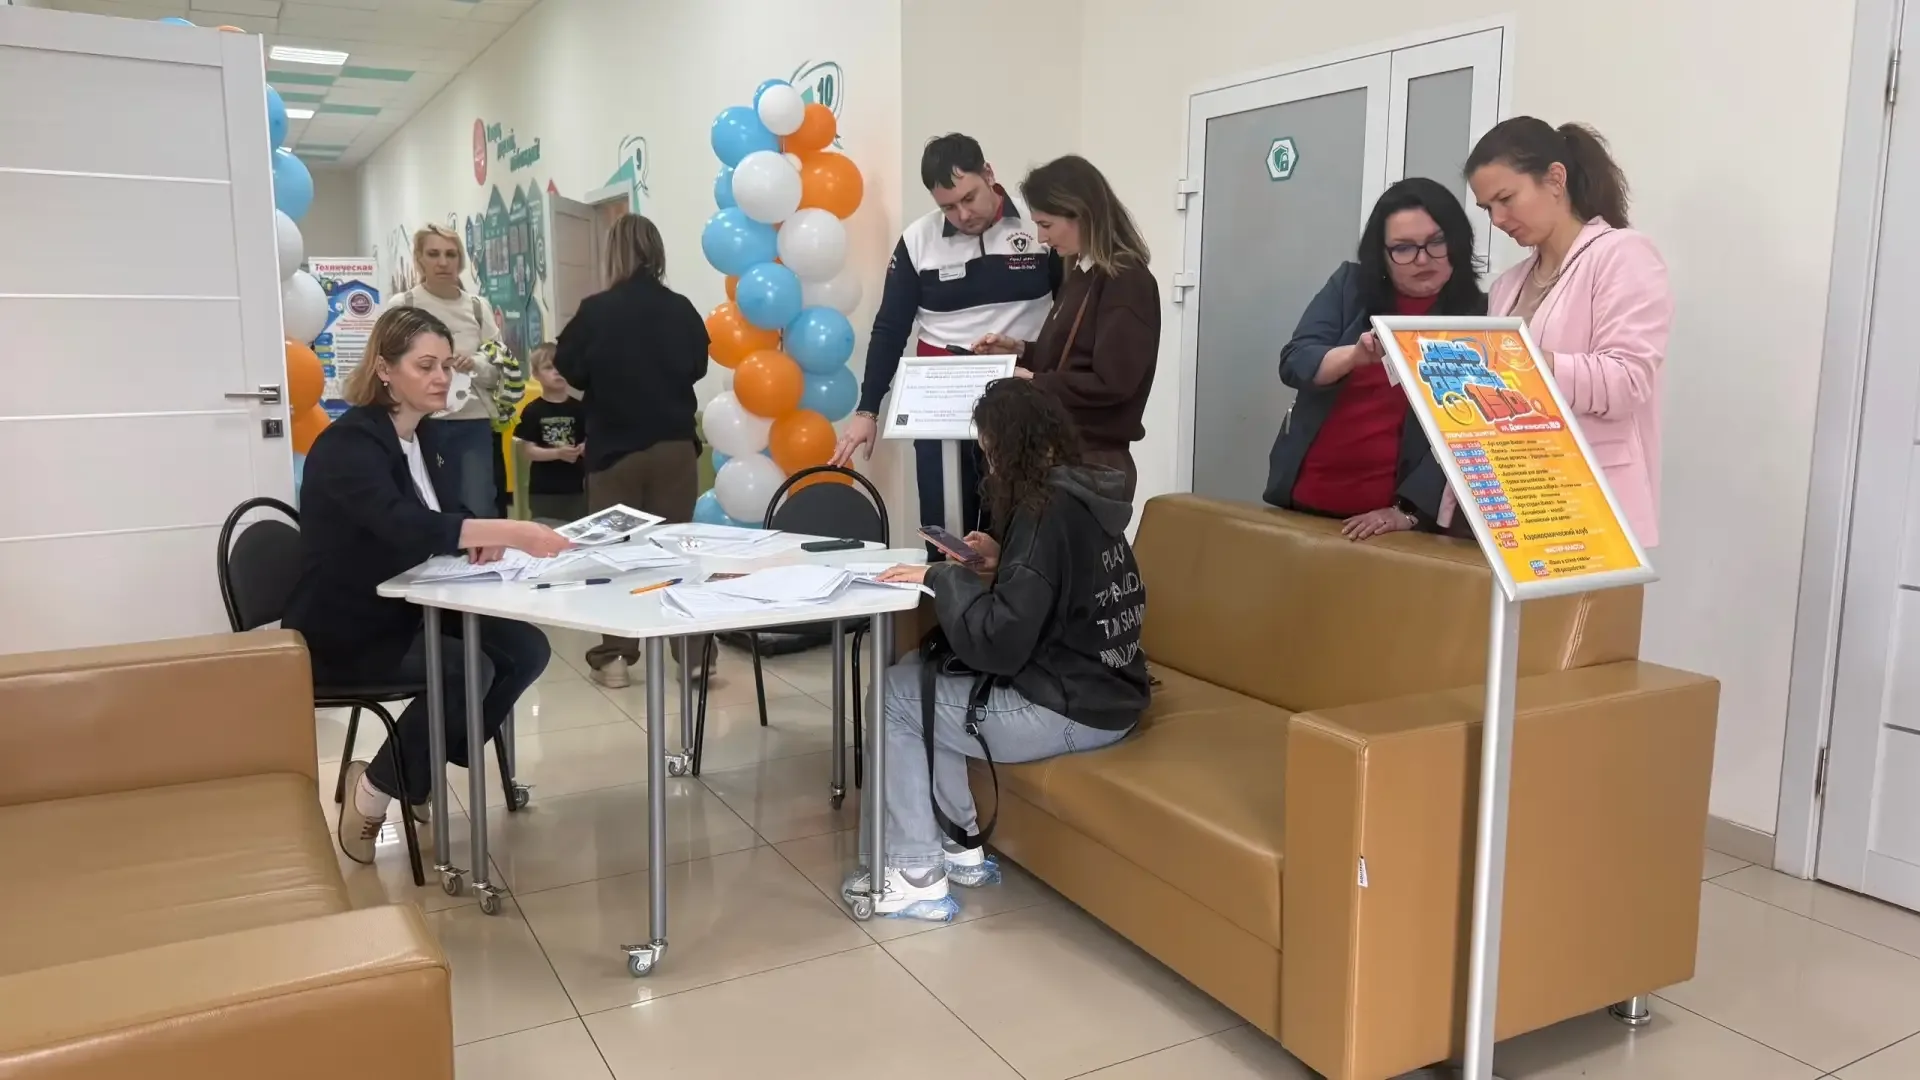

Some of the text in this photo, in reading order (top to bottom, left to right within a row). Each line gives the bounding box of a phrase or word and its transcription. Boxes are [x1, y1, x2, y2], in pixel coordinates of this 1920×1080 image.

[816, 74, 834, 107] 10
[636, 147, 642, 171] 9
[315, 263, 374, 272] Техническая
[1420, 341, 1481, 361] ДЕНЬ
[1419, 362, 1488, 377] ОТКРЫТЫХ
[1101, 542, 1125, 573] PLAY
